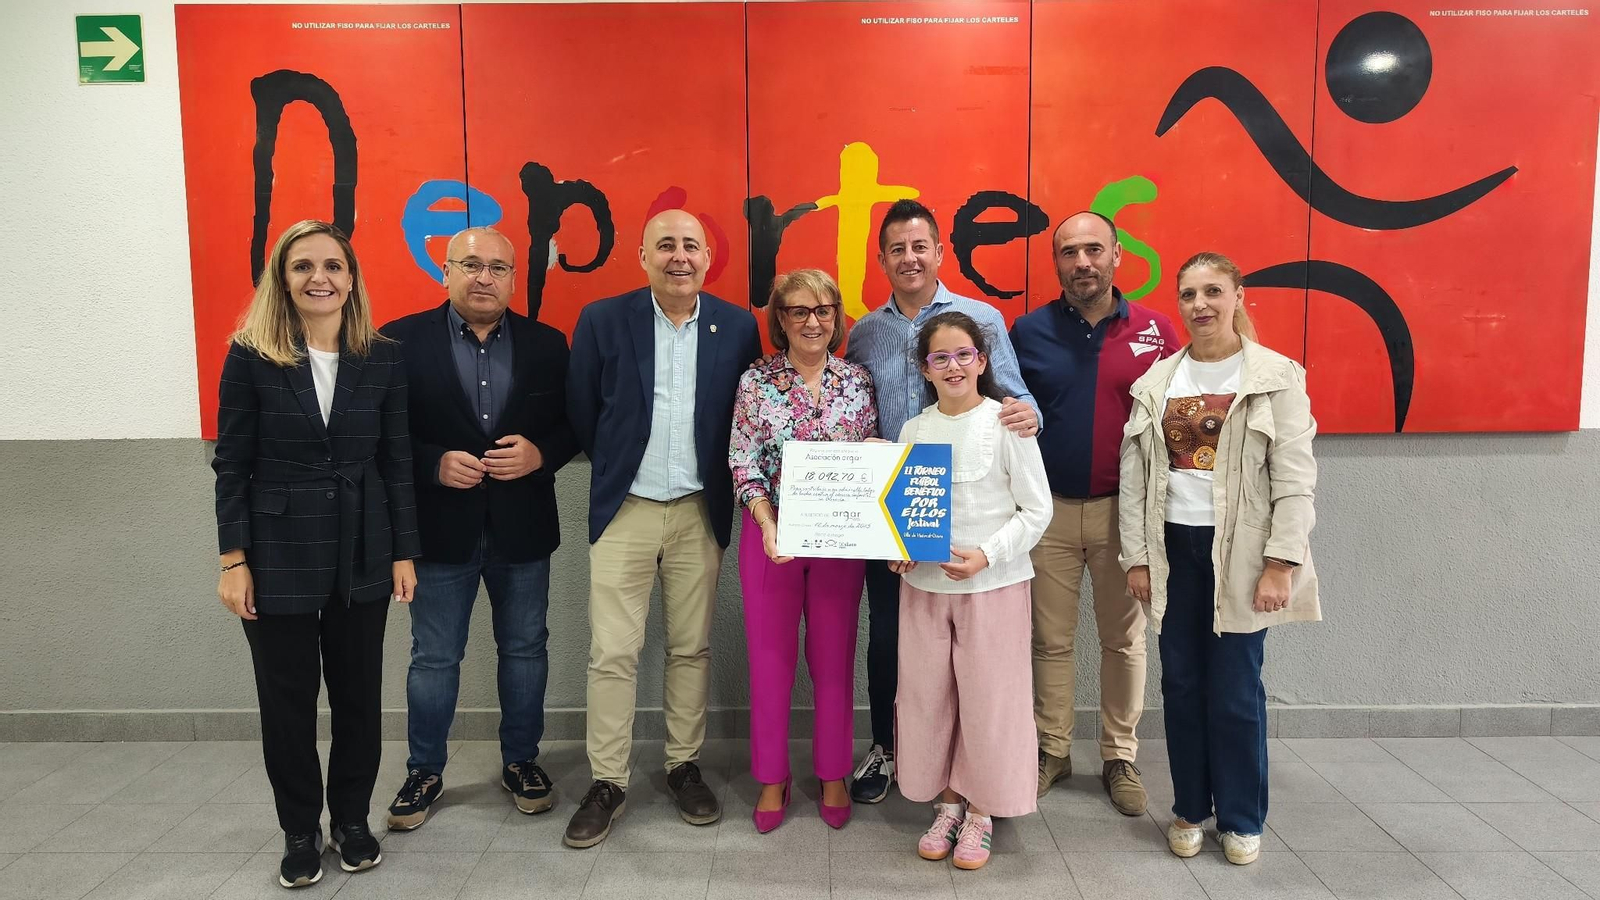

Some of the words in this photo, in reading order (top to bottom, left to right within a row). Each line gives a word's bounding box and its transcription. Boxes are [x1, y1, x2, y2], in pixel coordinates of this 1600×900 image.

[1138, 336, 1165, 345] SPAG
[914, 465, 947, 476] TORNEO
[910, 496, 938, 508] POR
[832, 510, 862, 521] argar
[901, 508, 948, 518] ELLOS
[907, 518, 940, 530] festival
